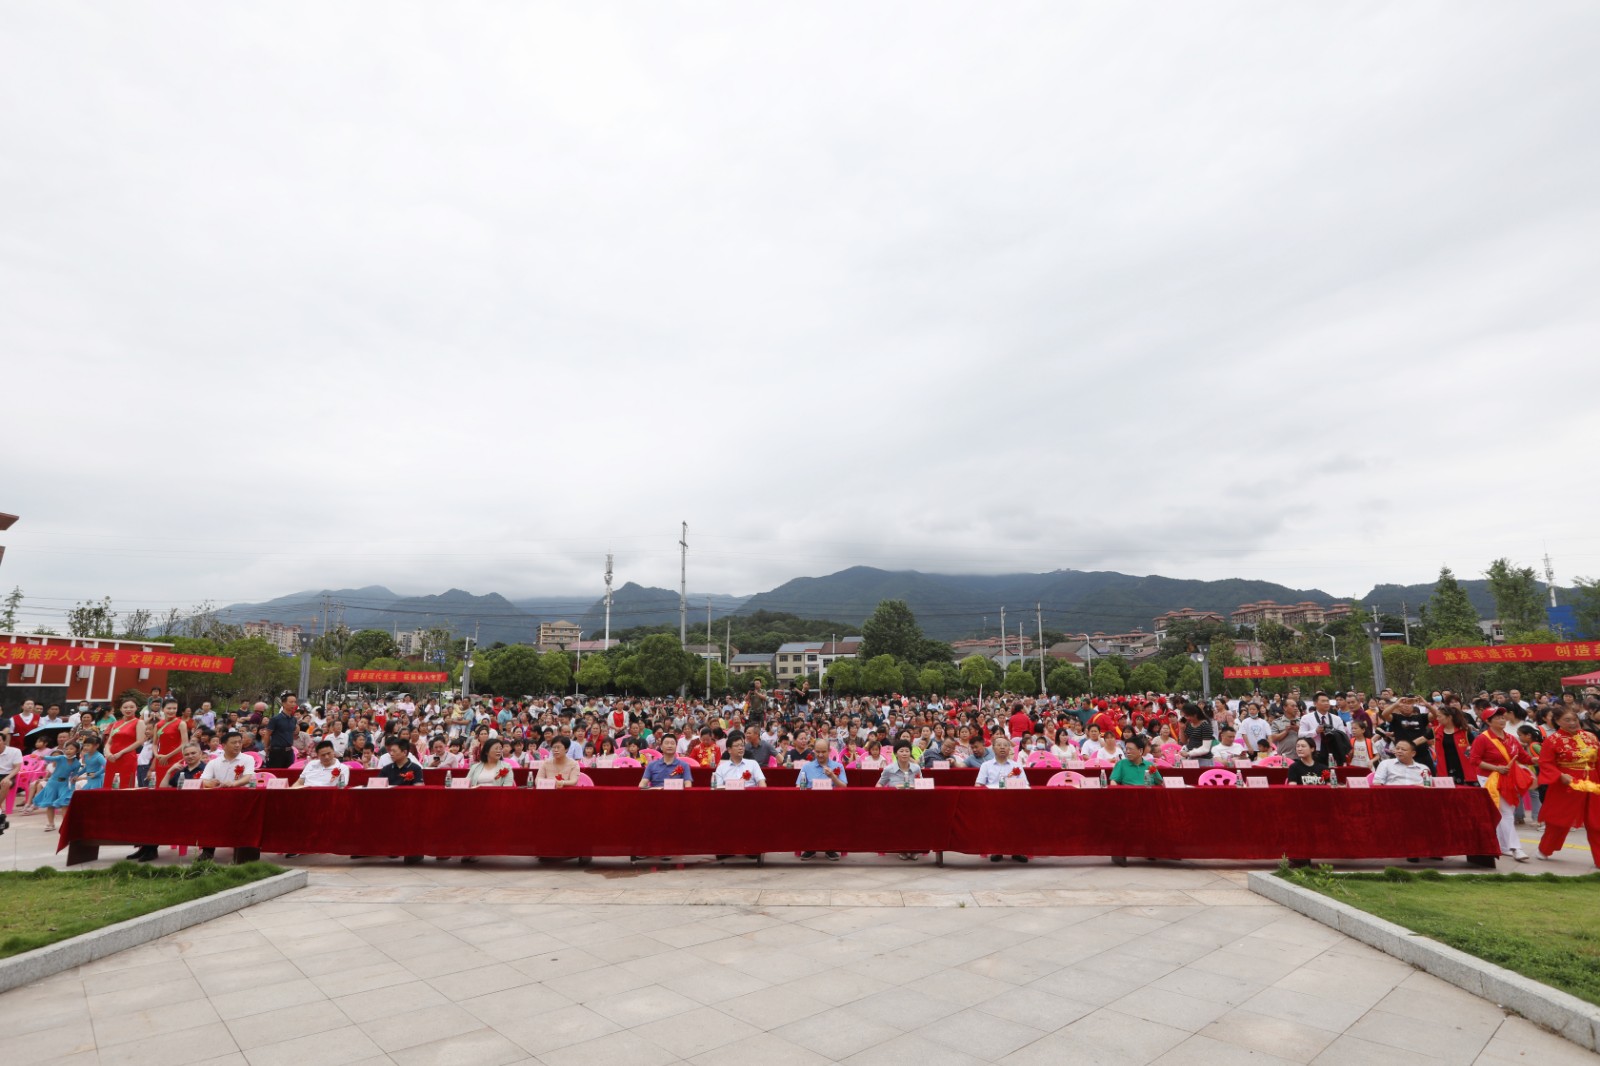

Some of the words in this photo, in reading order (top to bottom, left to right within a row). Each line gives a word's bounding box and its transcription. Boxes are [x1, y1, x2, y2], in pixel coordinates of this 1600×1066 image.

[128, 653, 222, 669] 文明薪火代代相传
[1443, 647, 1533, 661] 激发非遗活力
[1228, 668, 1270, 677] 人民的非遗
